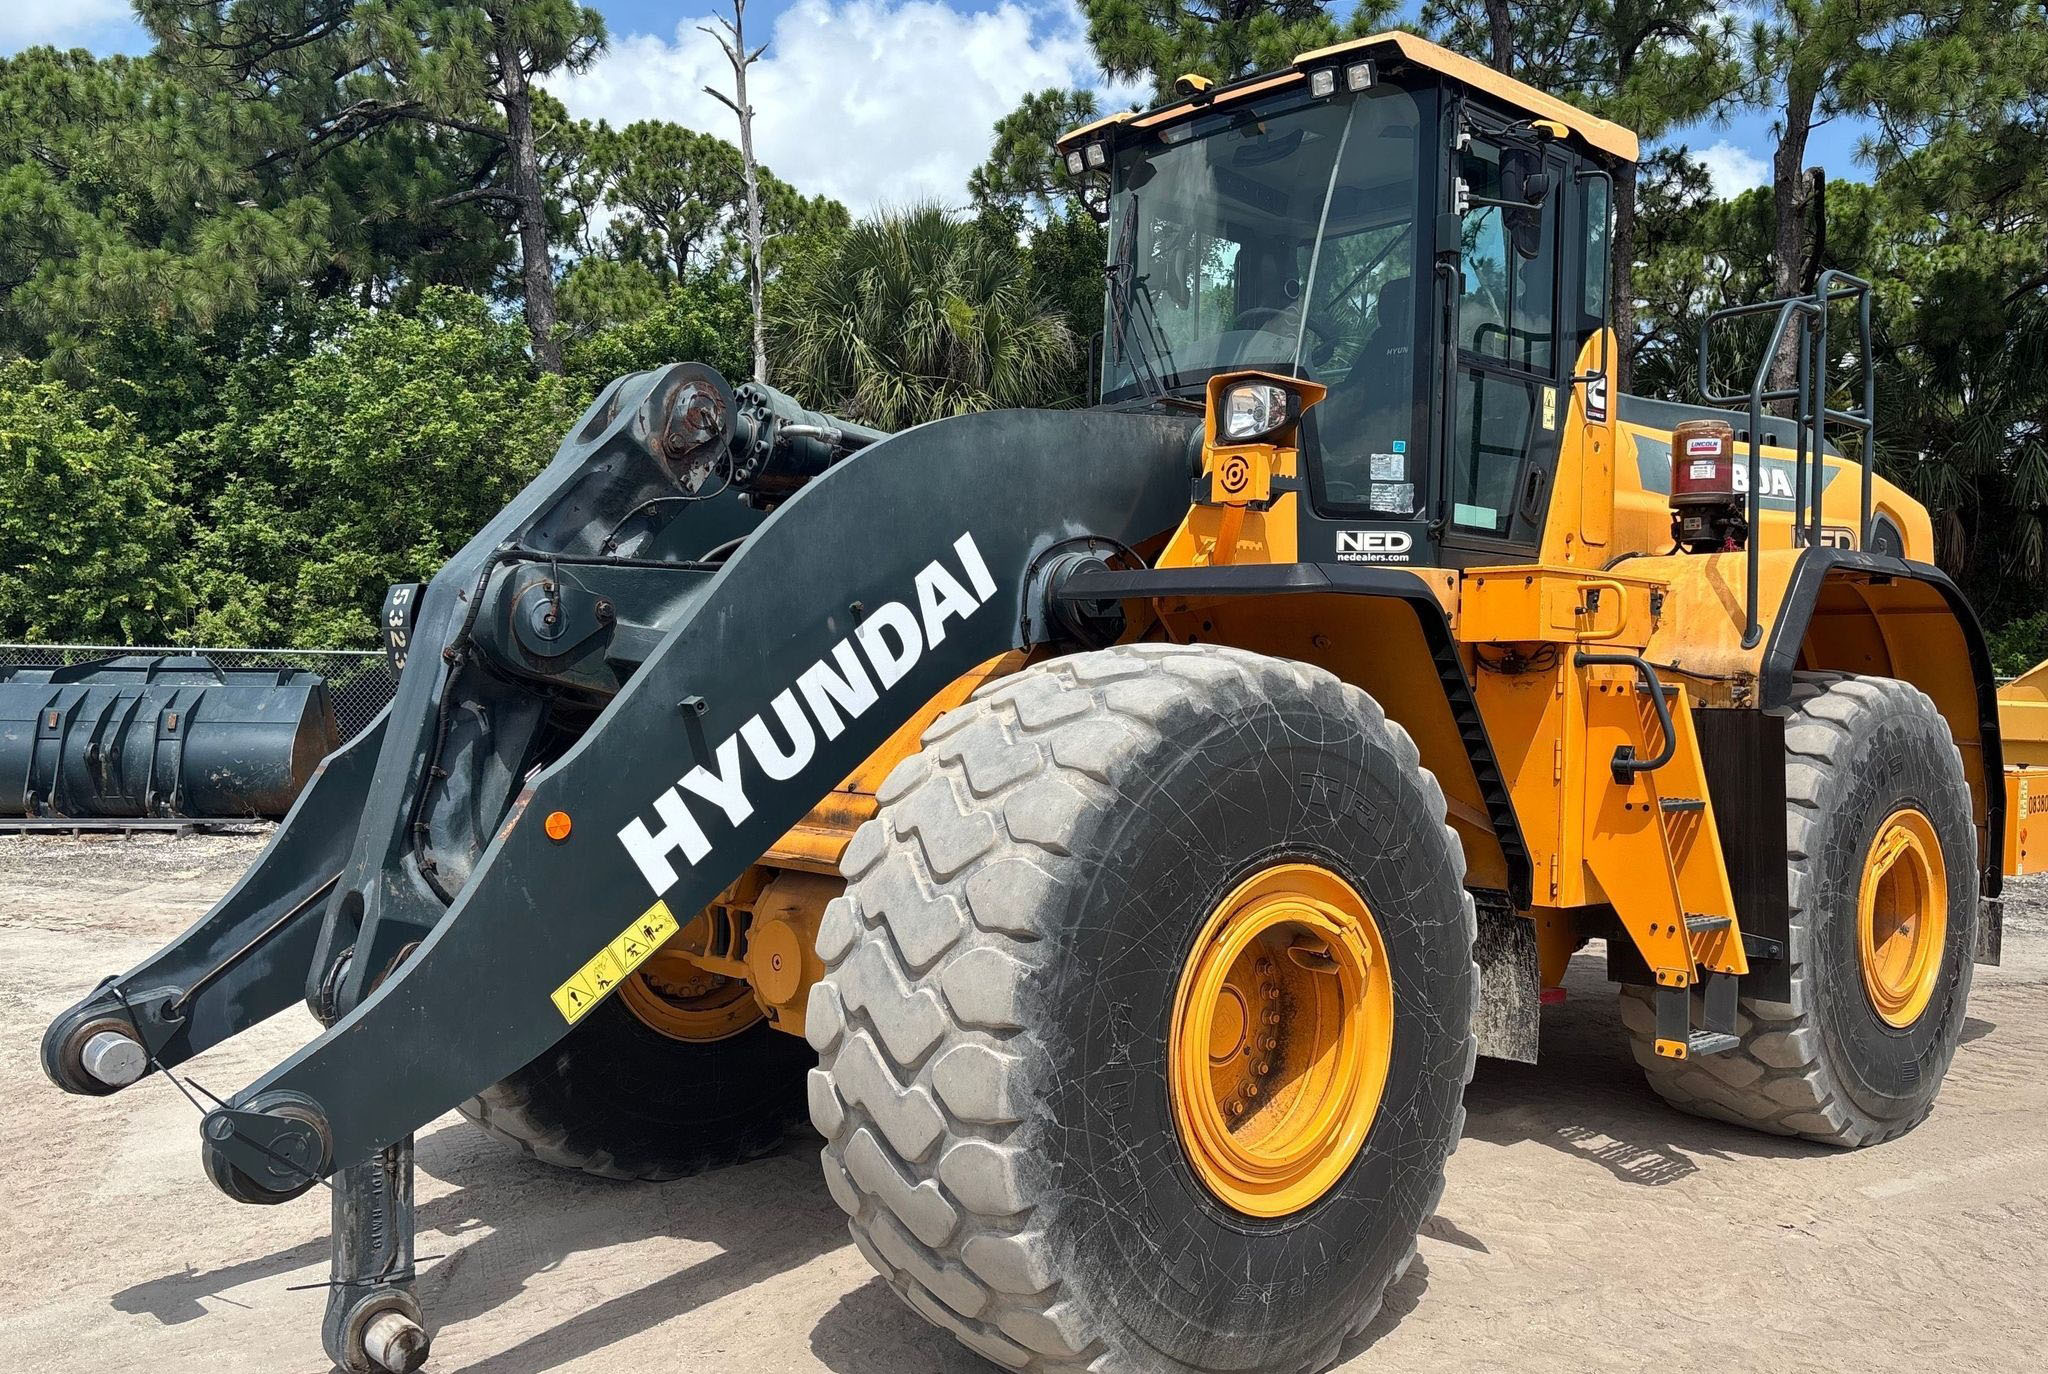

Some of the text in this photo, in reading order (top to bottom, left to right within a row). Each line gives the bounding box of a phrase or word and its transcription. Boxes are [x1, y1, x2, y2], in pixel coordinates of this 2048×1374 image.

[1336, 531, 1413, 553] NED
[1337, 553, 1410, 562] nedealers.com
[617, 530, 998, 897] HYUNDAI
